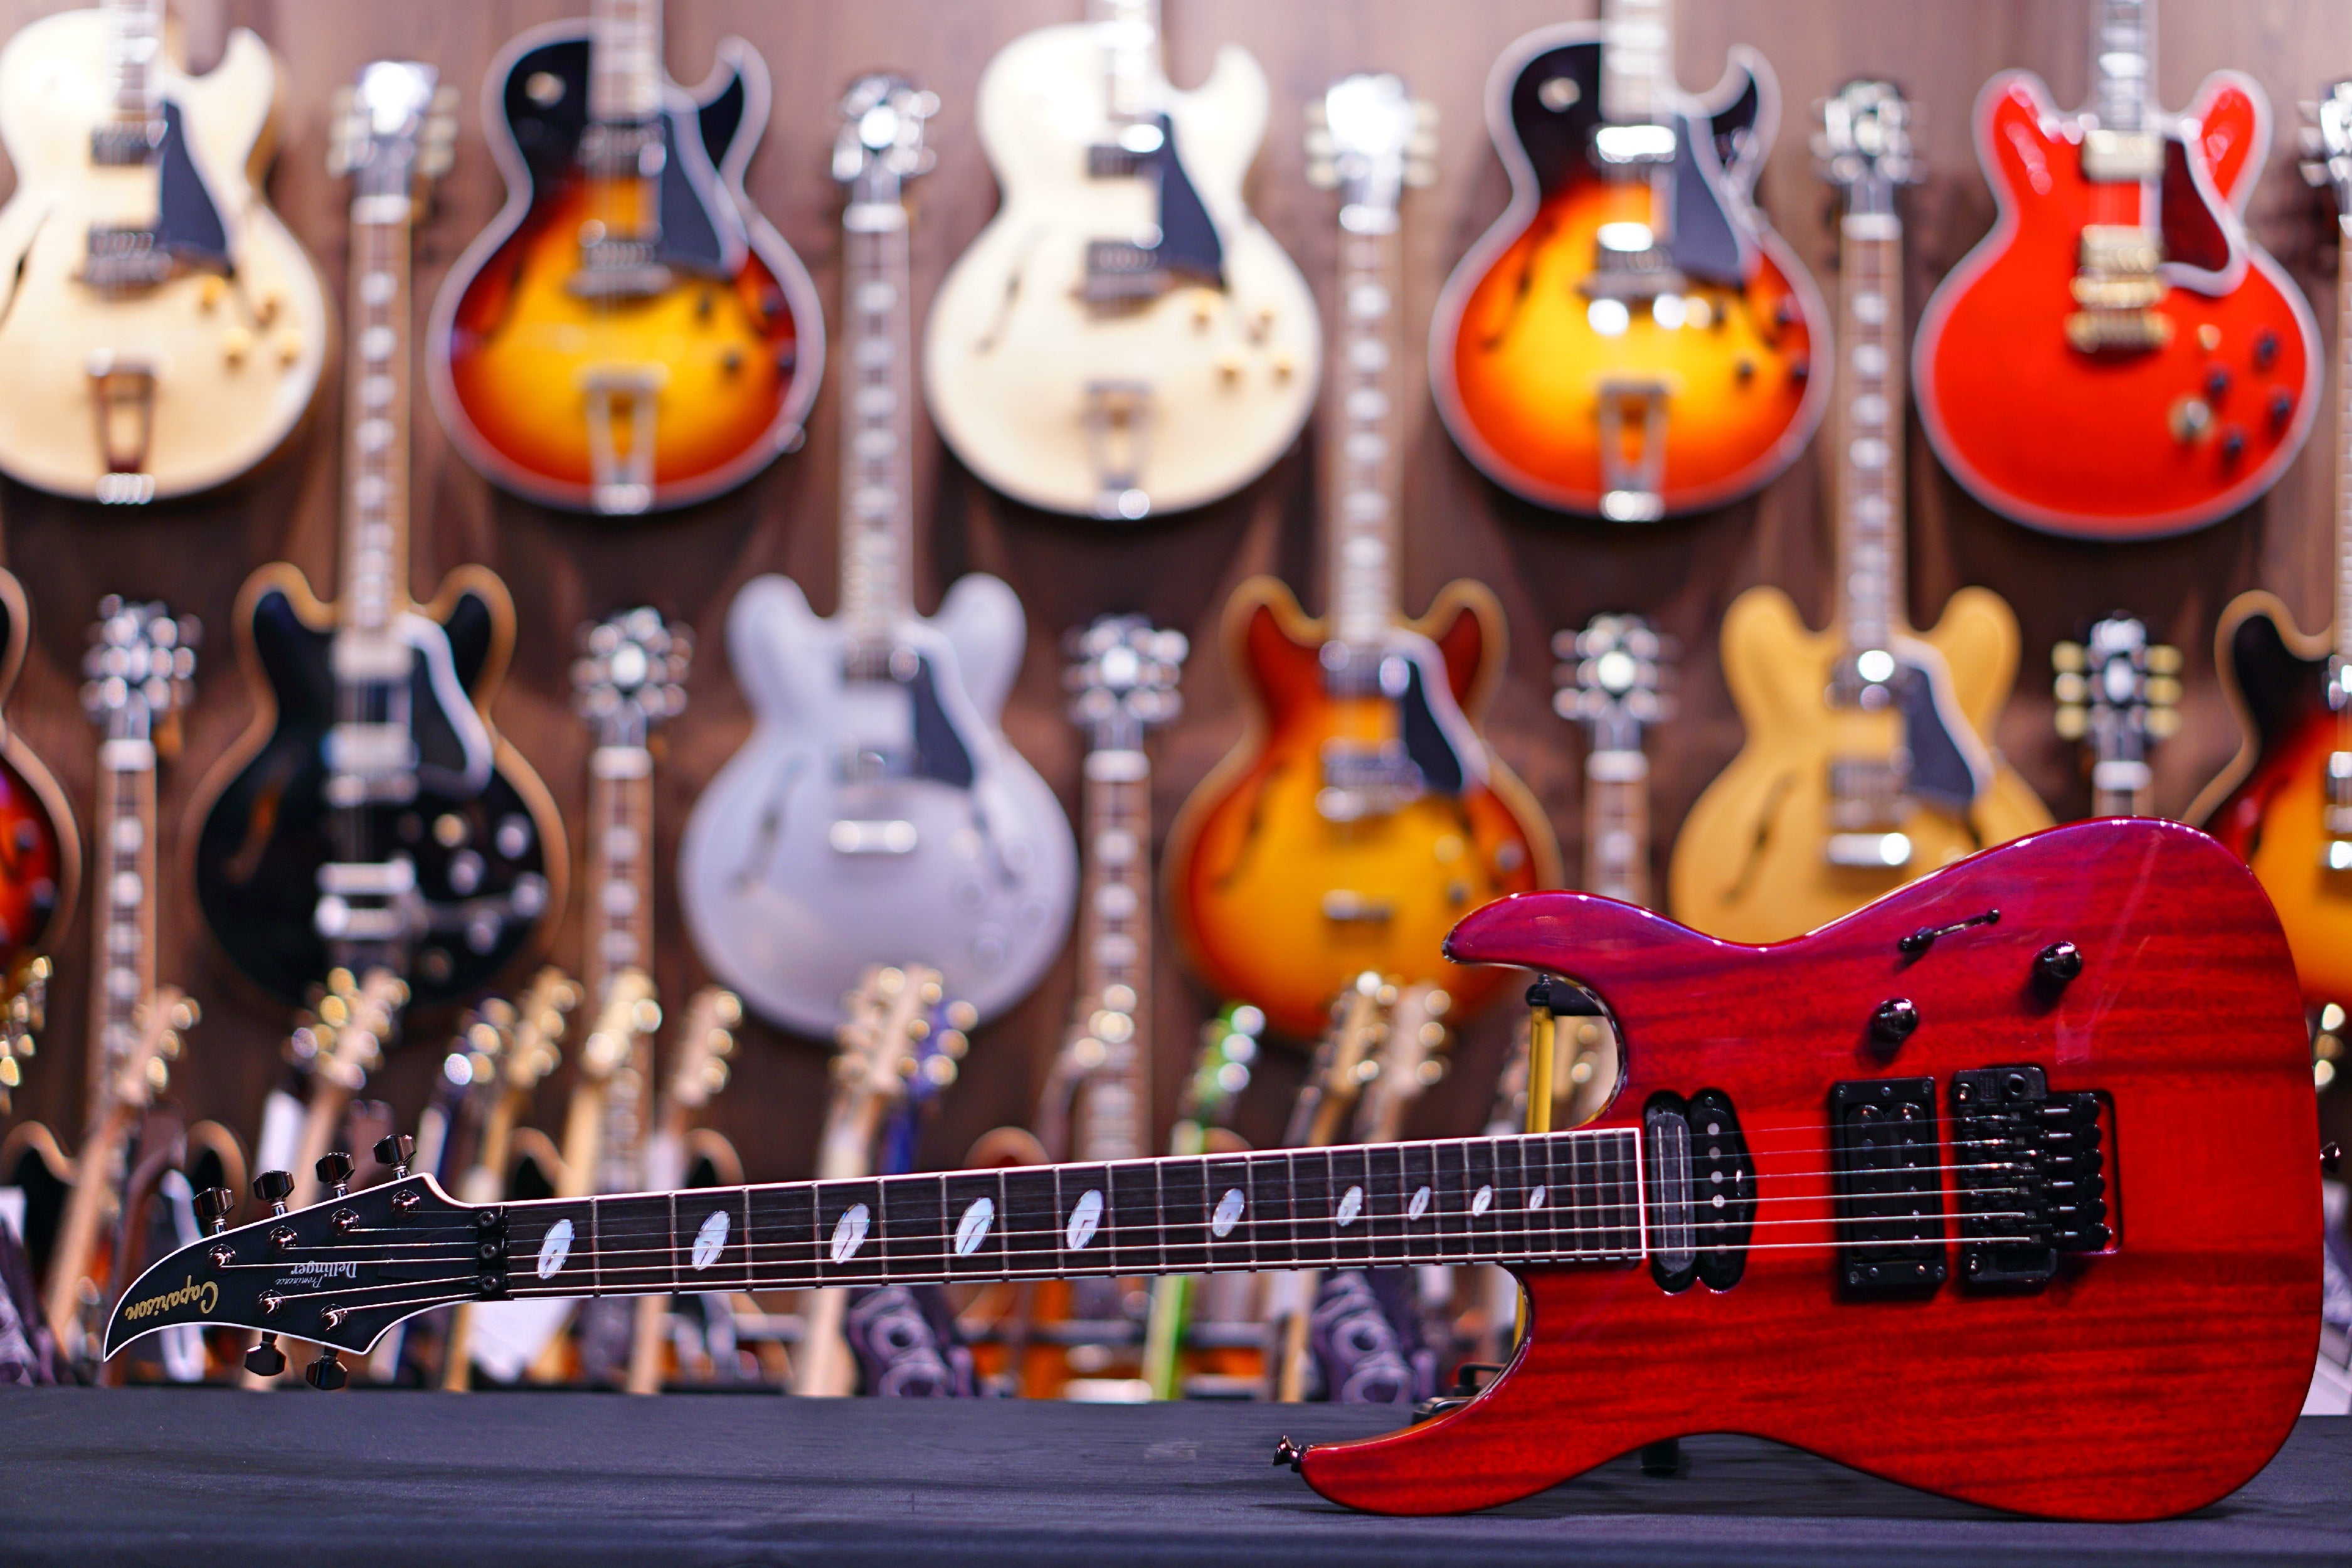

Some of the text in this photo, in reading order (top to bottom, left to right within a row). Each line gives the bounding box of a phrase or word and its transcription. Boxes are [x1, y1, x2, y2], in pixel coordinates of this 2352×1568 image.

[290, 1261, 358, 1278] Dellinger
[275, 1276, 322, 1288] Prominence
[125, 1276, 218, 1320] Caparison
